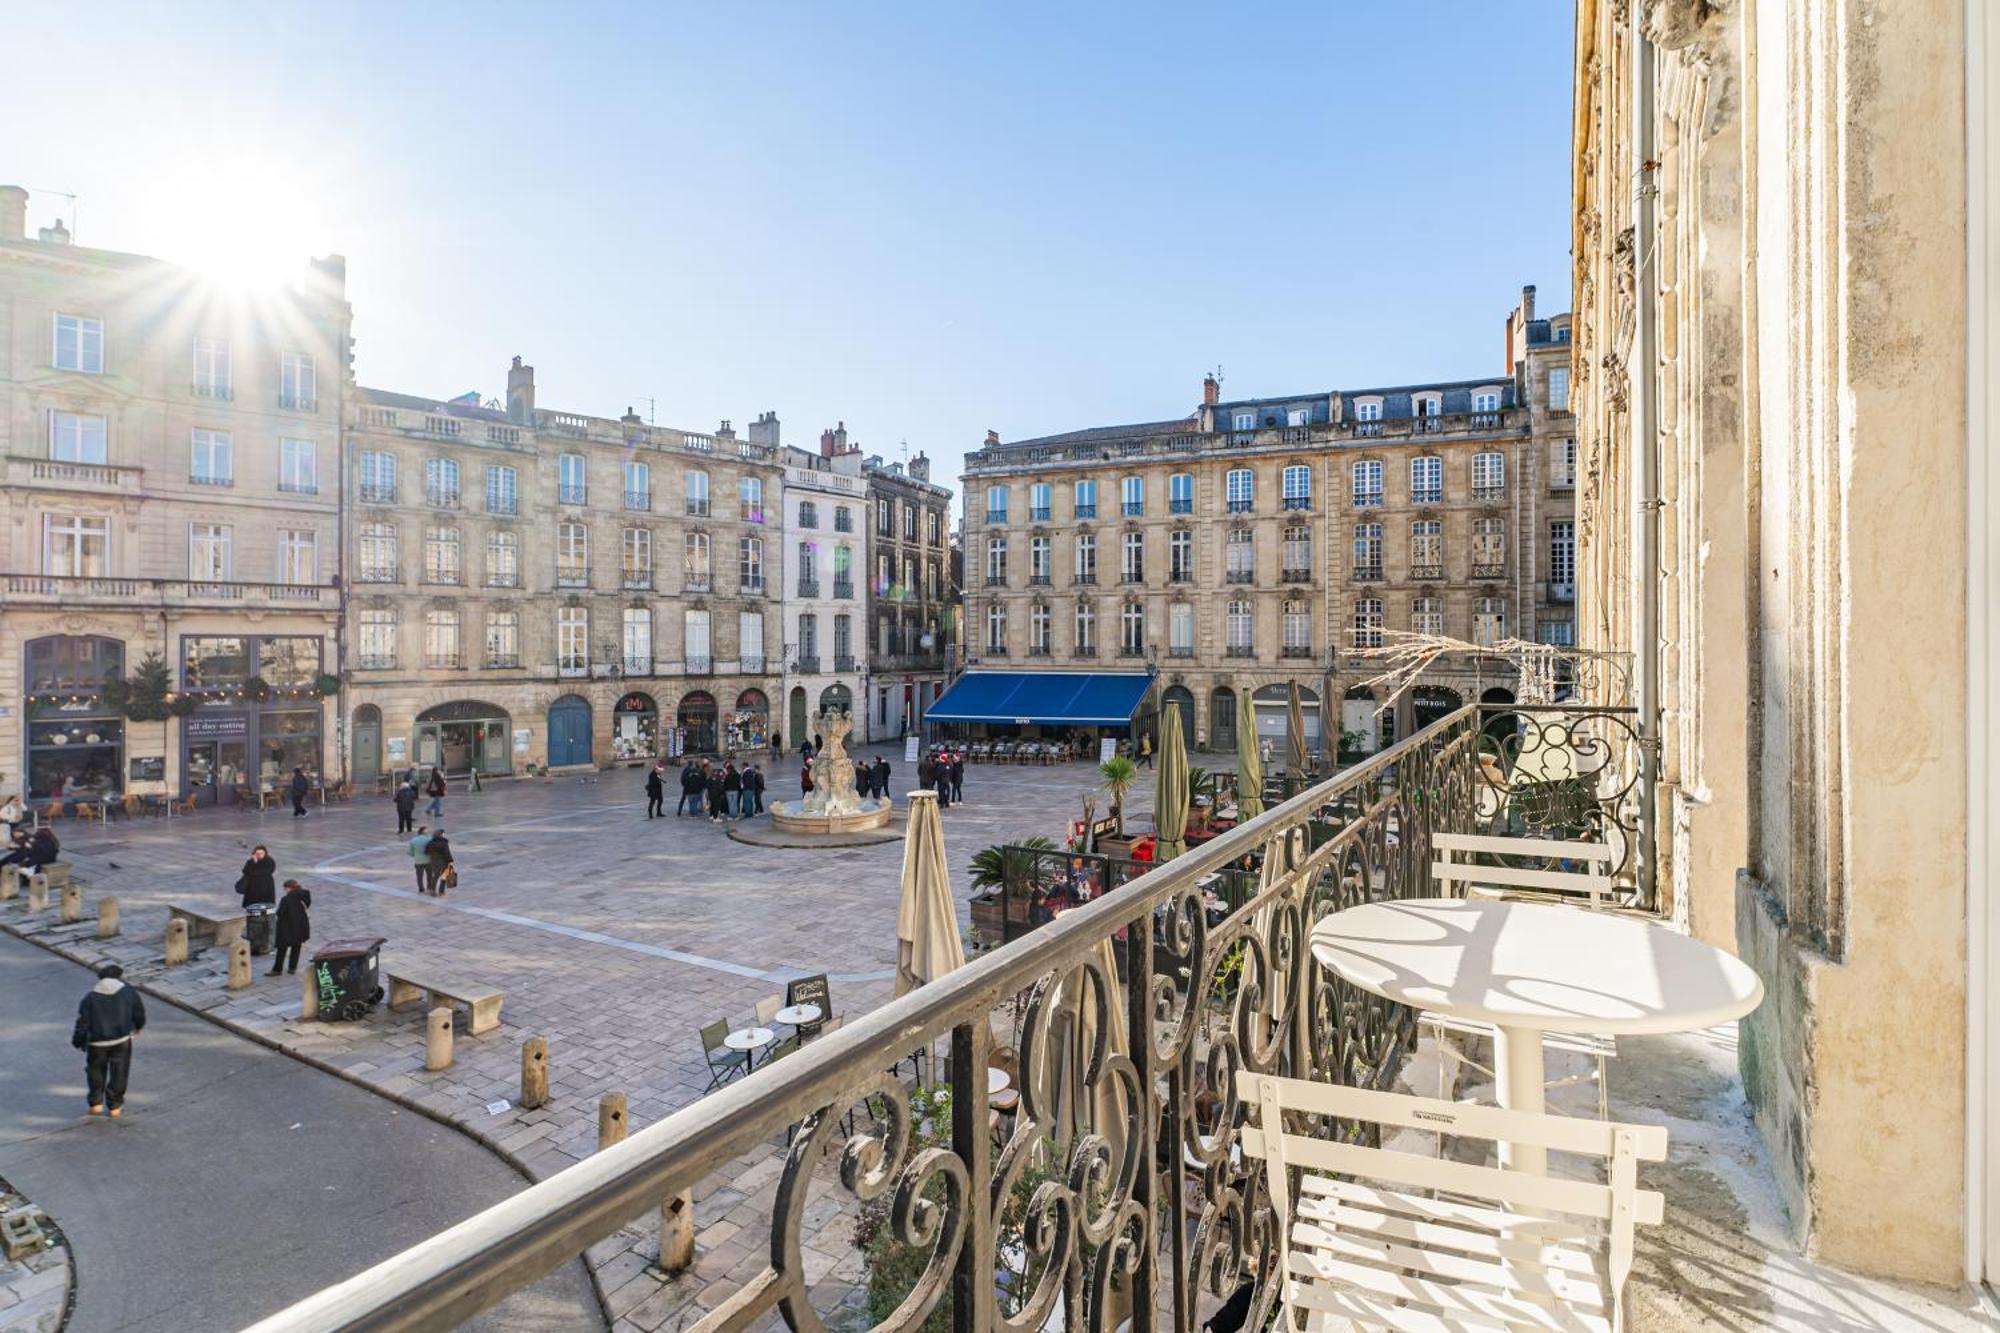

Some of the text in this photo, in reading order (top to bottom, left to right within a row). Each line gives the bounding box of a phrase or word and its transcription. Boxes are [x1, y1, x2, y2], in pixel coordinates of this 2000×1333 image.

[188, 722, 246, 731] all day eating
